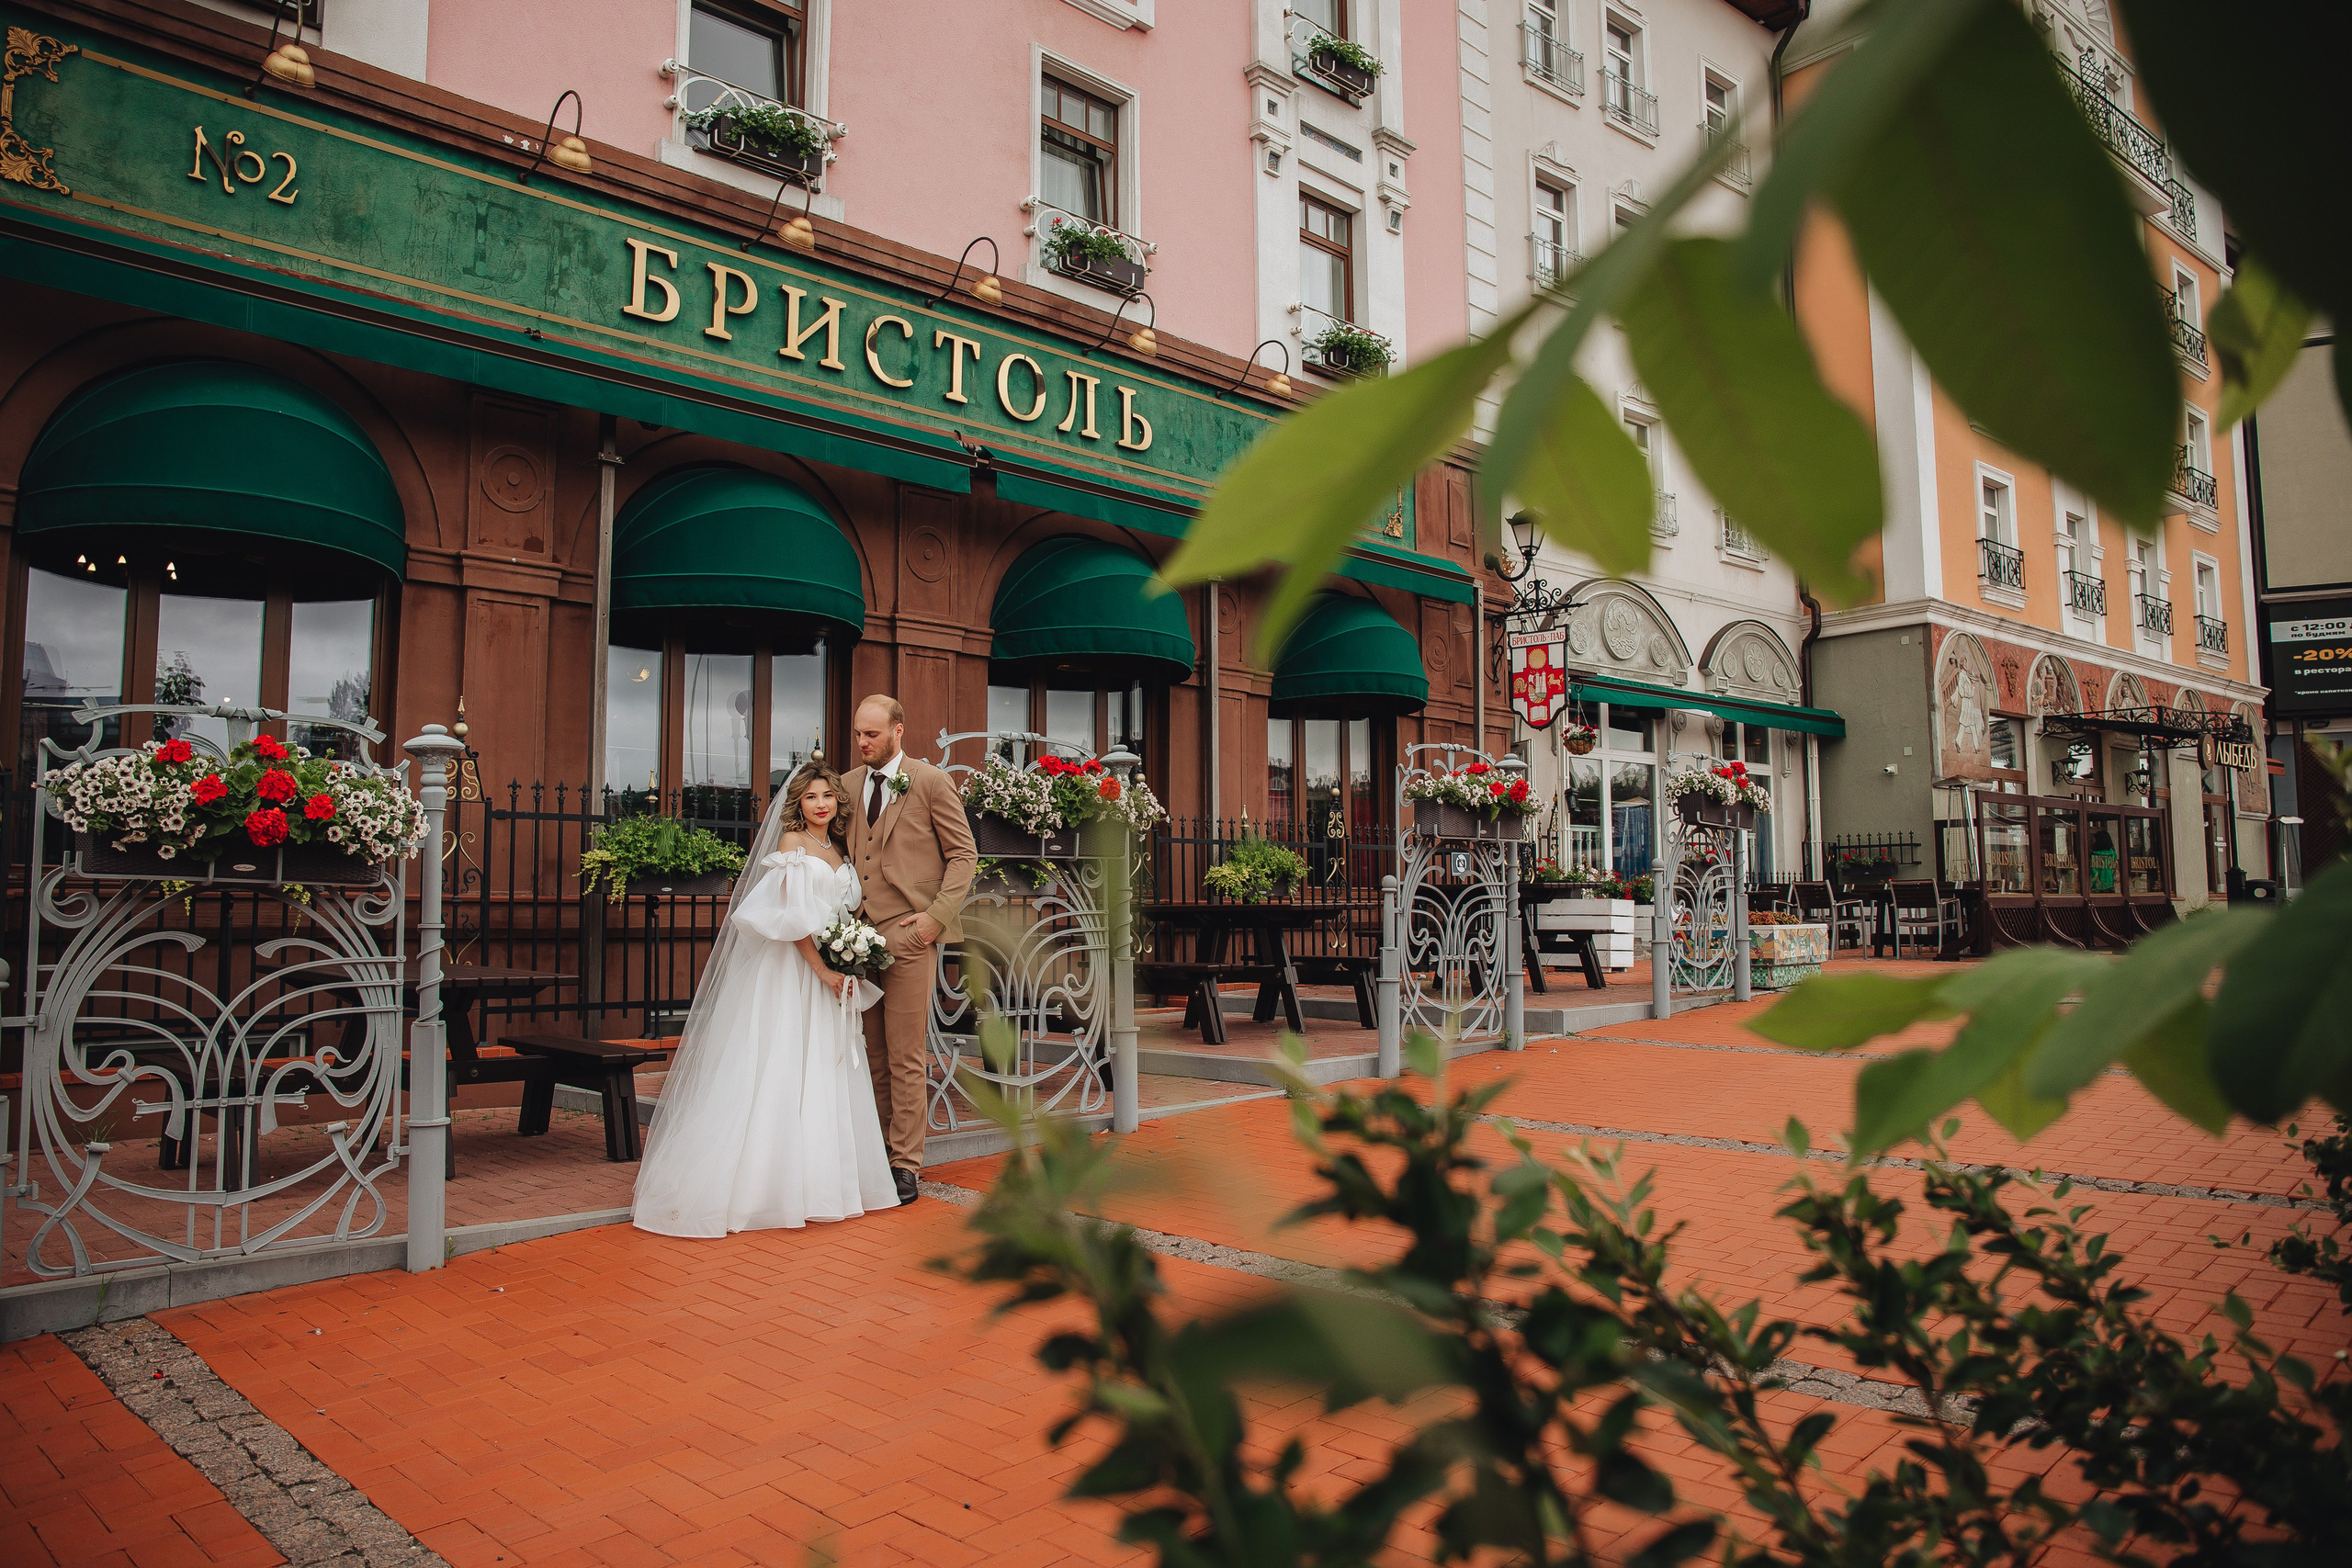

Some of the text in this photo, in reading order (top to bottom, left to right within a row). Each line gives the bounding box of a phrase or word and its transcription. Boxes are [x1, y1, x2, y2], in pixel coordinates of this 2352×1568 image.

[622, 236, 1154, 452] БРИСТОЛЬ
[2302, 622, 2346, 630] 12:00
[1511, 631, 1565, 646] БРИСТОЛЬ ПАБ
[2293, 648, 2352, 660] -20%
[2216, 740, 2256, 772] ЛЫБЕДЬ
[1990, 851, 2026, 867] BRISTOL
[2043, 852, 2075, 868] BRISTOL
[2091, 854, 2117, 870] BRISTOL
[2131, 856, 2157, 869] BRISTOL
